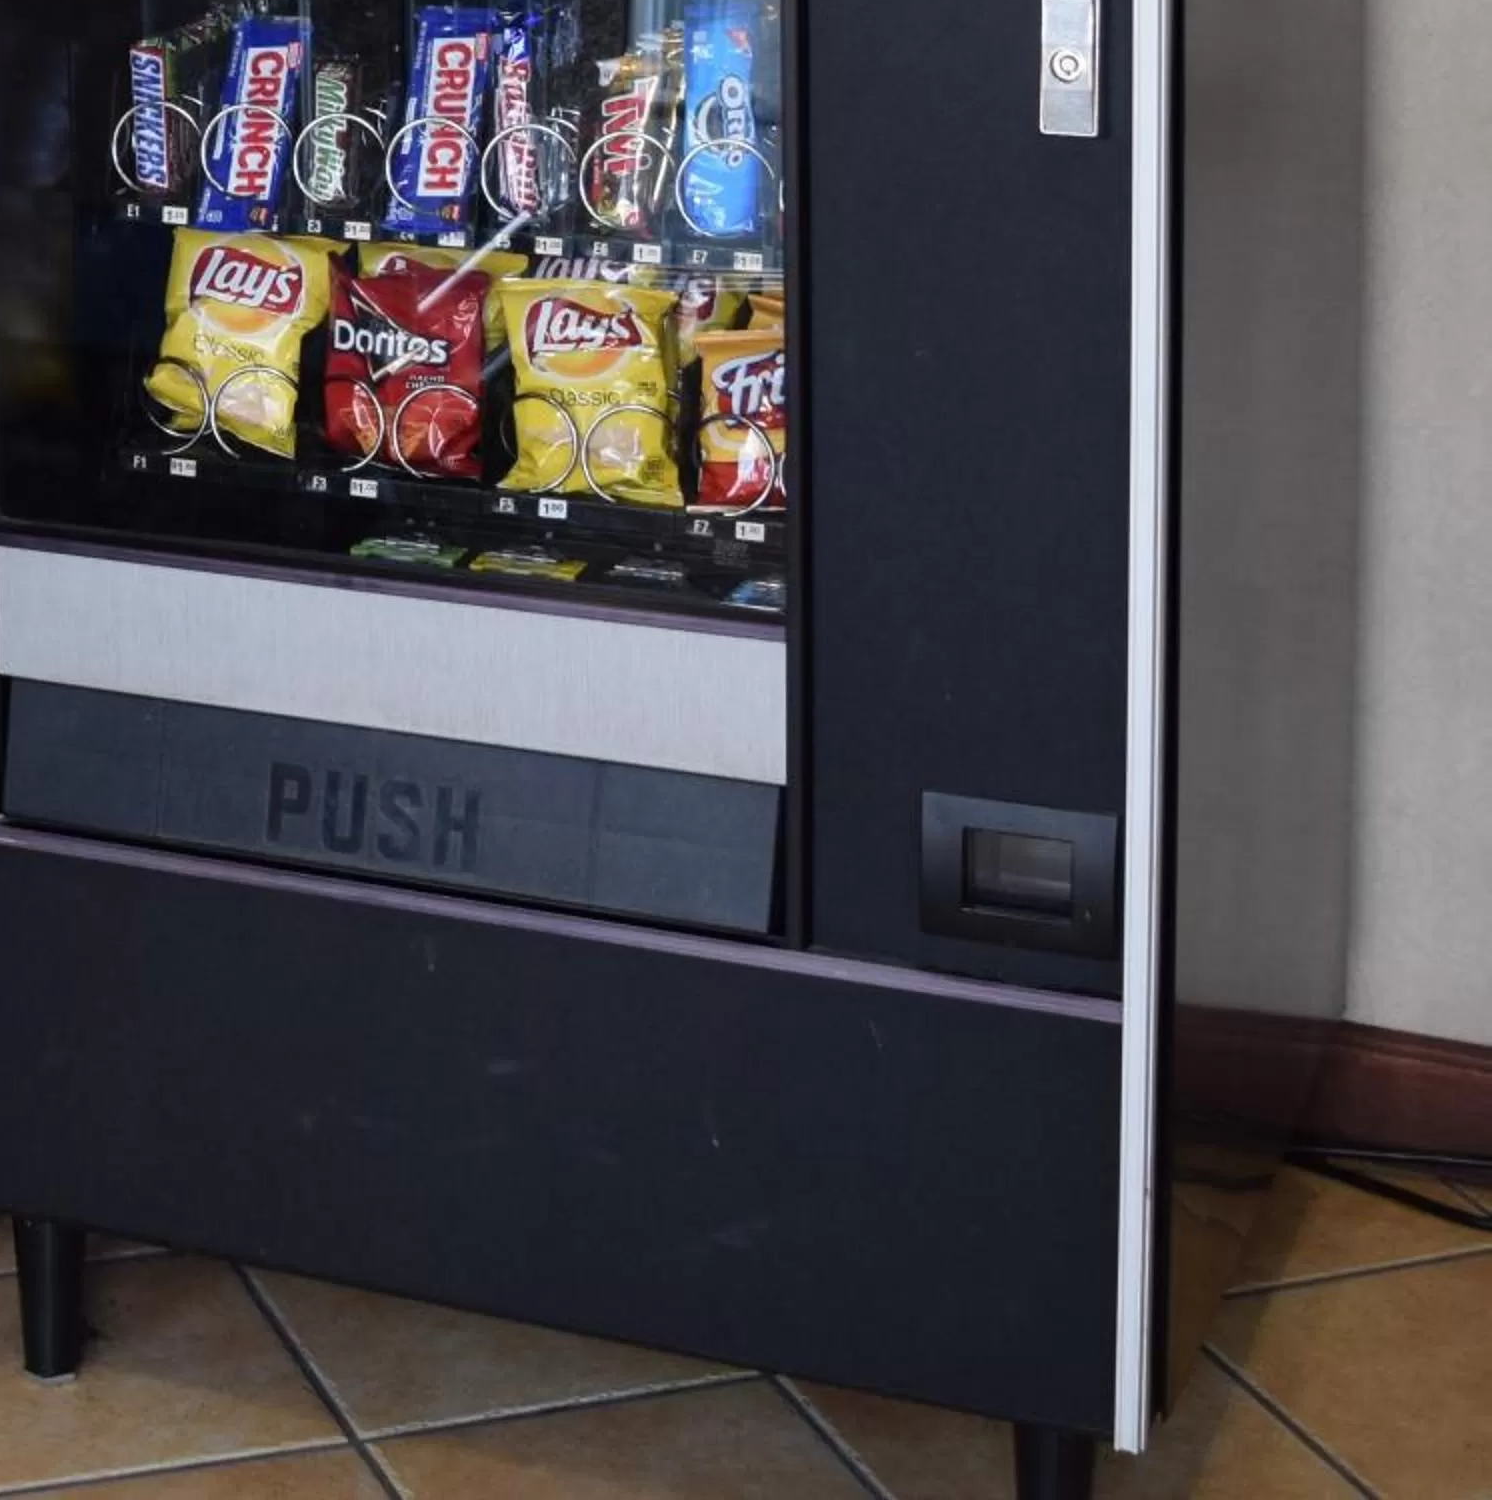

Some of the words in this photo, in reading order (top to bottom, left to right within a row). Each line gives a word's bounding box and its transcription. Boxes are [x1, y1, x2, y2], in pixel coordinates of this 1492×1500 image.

[233, 50, 286, 196] CRUNCH
[423, 41, 476, 192] CRUNCH
[194, 249, 299, 308] Lay's
[333, 319, 449, 365] Doritos
[531, 299, 636, 353] Lay's
[133, 455, 147, 469] F1
[267, 760, 482, 874] PUSH
